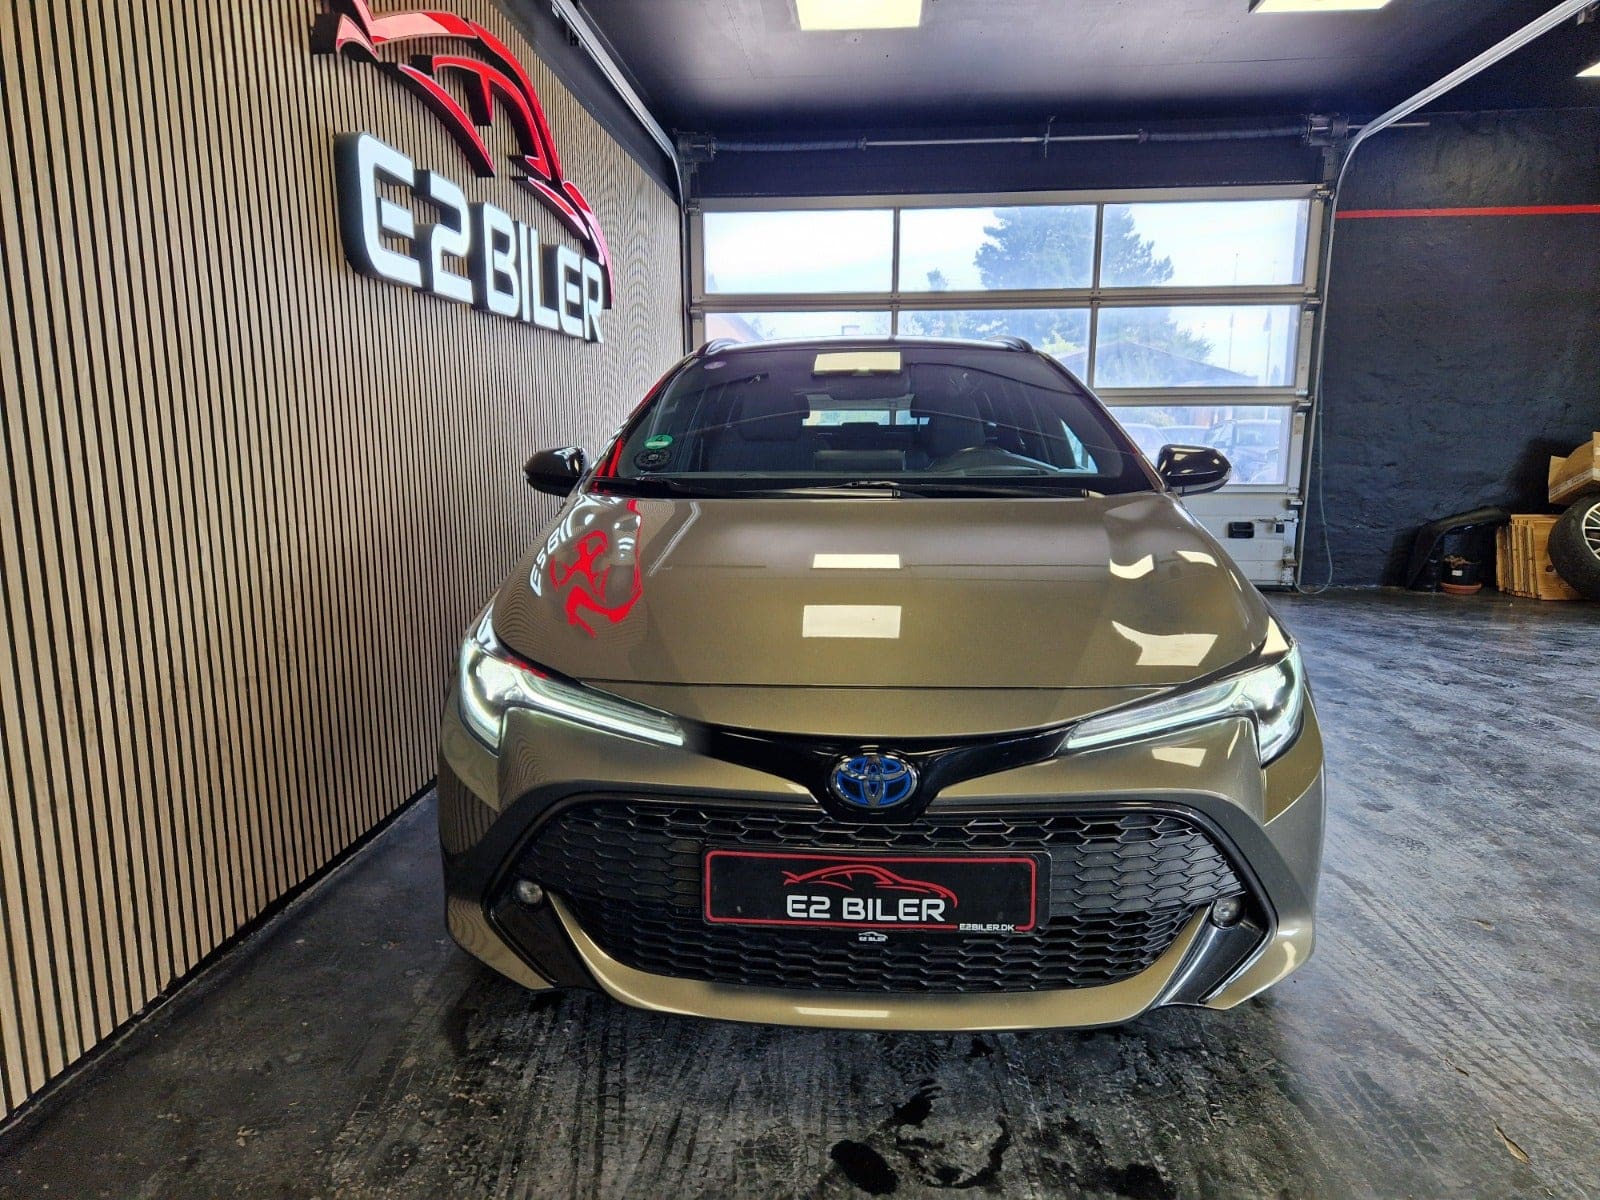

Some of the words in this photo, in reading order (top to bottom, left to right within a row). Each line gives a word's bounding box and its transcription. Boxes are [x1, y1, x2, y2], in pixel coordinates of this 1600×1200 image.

[356, 131, 474, 305] E2
[482, 202, 604, 344] BILER
[786, 894, 831, 919] E2
[842, 897, 946, 922] BILER
[959, 923, 1015, 931] E2BILER.DK
